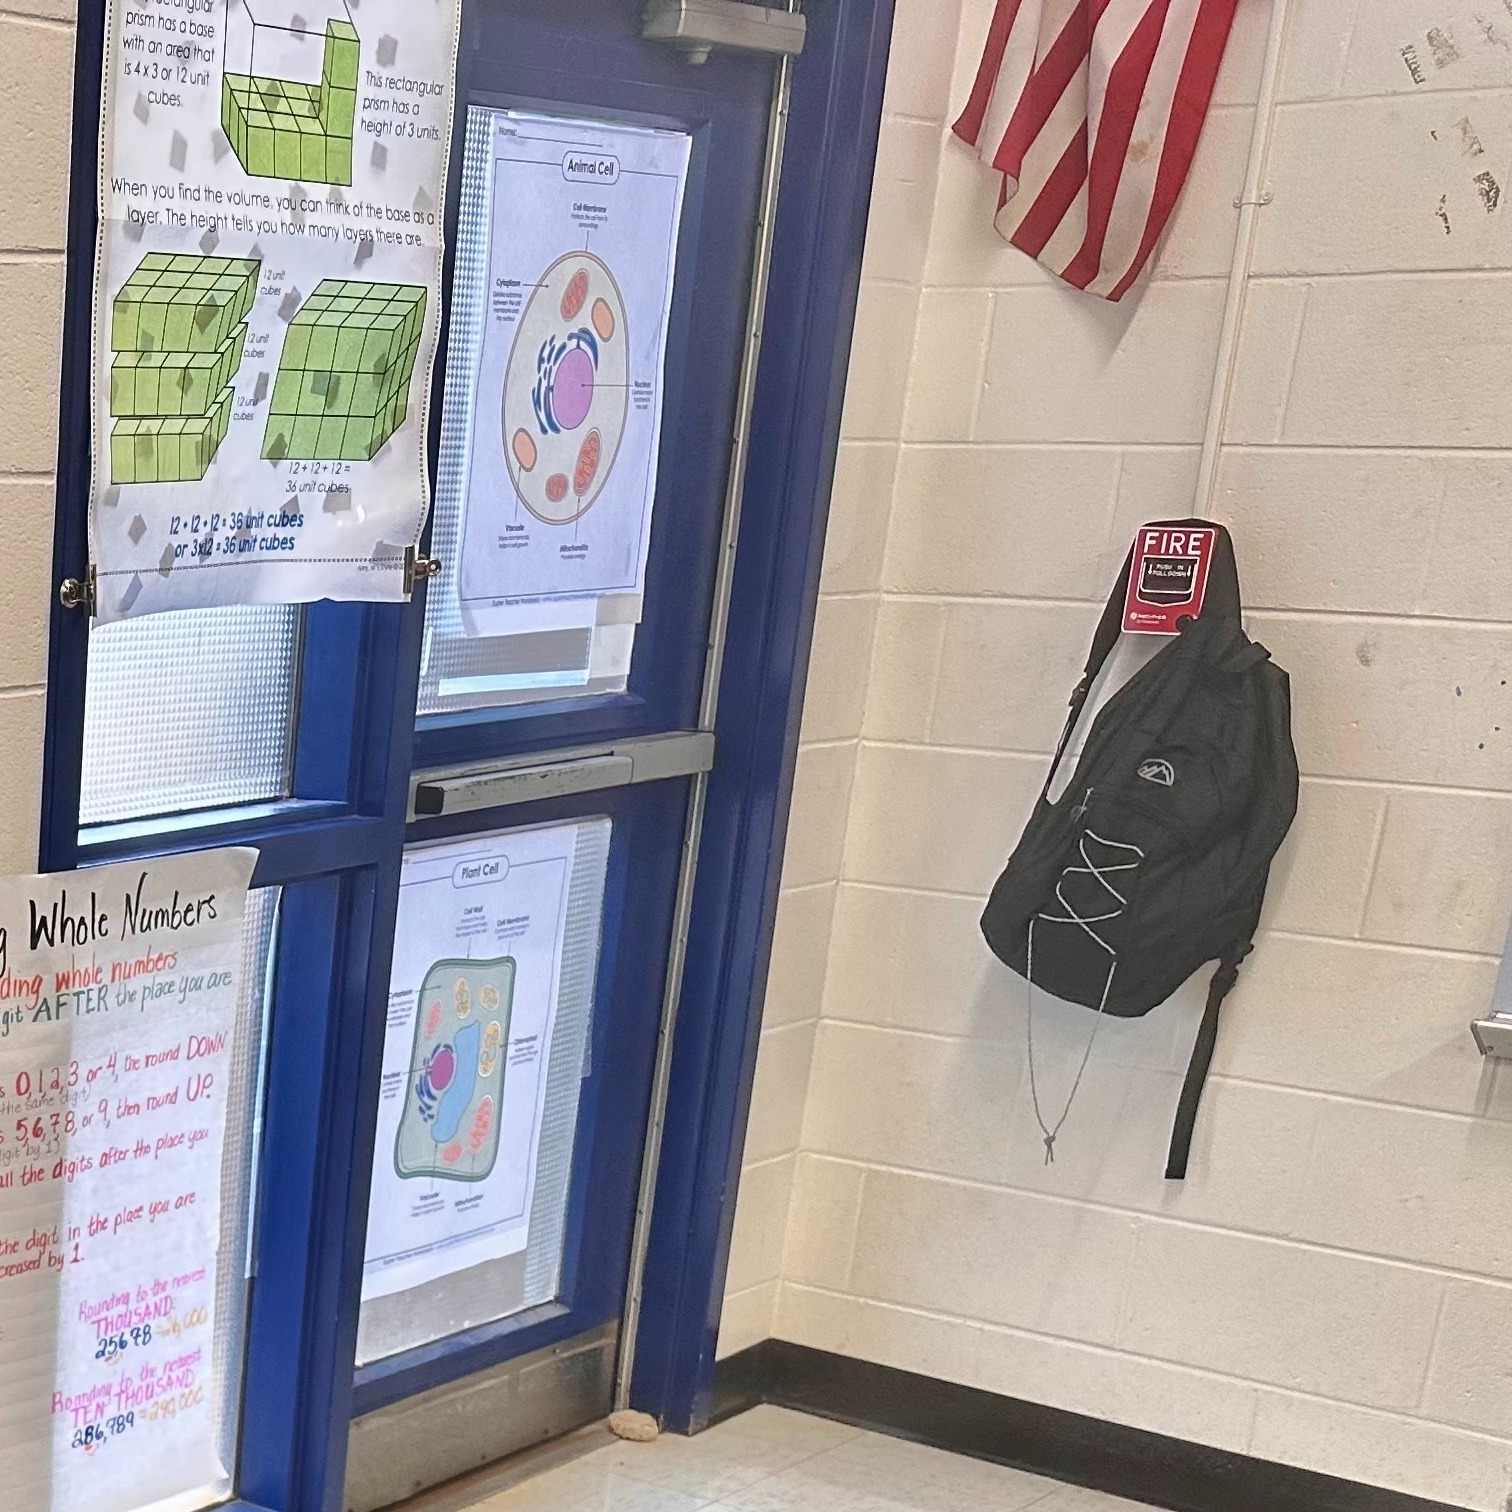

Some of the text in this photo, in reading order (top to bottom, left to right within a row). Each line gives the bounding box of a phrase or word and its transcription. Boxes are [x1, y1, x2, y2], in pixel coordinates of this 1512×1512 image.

[126, 10, 214, 38] prism has a base
[123, 35, 214, 62] with an area that
[124, 59, 209, 86] is 4 x 3 or 12 unit
[366, 71, 444, 97] This rectangular
[148, 88, 184, 107] cubes.
[363, 97, 419, 115] prism has a
[361, 117, 441, 140] height of 3 units.
[568, 159, 614, 176] Animal Cell
[111, 176, 147, 196] When
[152, 185, 174, 201] you
[179, 183, 200, 201] find
[204, 186, 222, 203] the
[277, 198, 296, 212] you
[300, 199, 322, 213] can
[326, 198, 350, 215] think
[353, 201, 363, 217] of
[366, 202, 382, 219] the
[386, 204, 410, 222] base
[414, 211, 424, 224] as
[427, 213, 434, 225] a
[127, 205, 424, 247] layer. The height tells you how many layers there are.
[286, 480, 297, 492] 36
[299, 480, 316, 492] unit
[175, 543, 188, 558] or
[191, 537, 213, 557] 3x12
[223, 537, 236, 554] 36
[238, 536, 257, 553] unit
[259, 533, 295, 550] cubes
[1144, 532, 1204, 555] FIRE
[461, 862, 499, 879] Plant Cell
[29, 890, 108, 950] Whole
[121, 872, 217, 941] Numbers
[55, 952, 103, 993] whole
[111, 945, 178, 983] numbers
[32, 984, 109, 1023] AFTER
[115, 982, 137, 1007] the
[141, 977, 174, 1012] place
[178, 975, 203, 1004] you
[207, 971, 232, 989] are
[21, 1165, 44, 1186] the
[52, 1157, 93, 1183] digits
[100, 1146, 129, 1168] after
[133, 1140, 151, 1159] the
[155, 1132, 185, 1160] place
[188, 1127, 209, 1149] you
[71, 1368, 194, 1428] TEN THOUSAND
